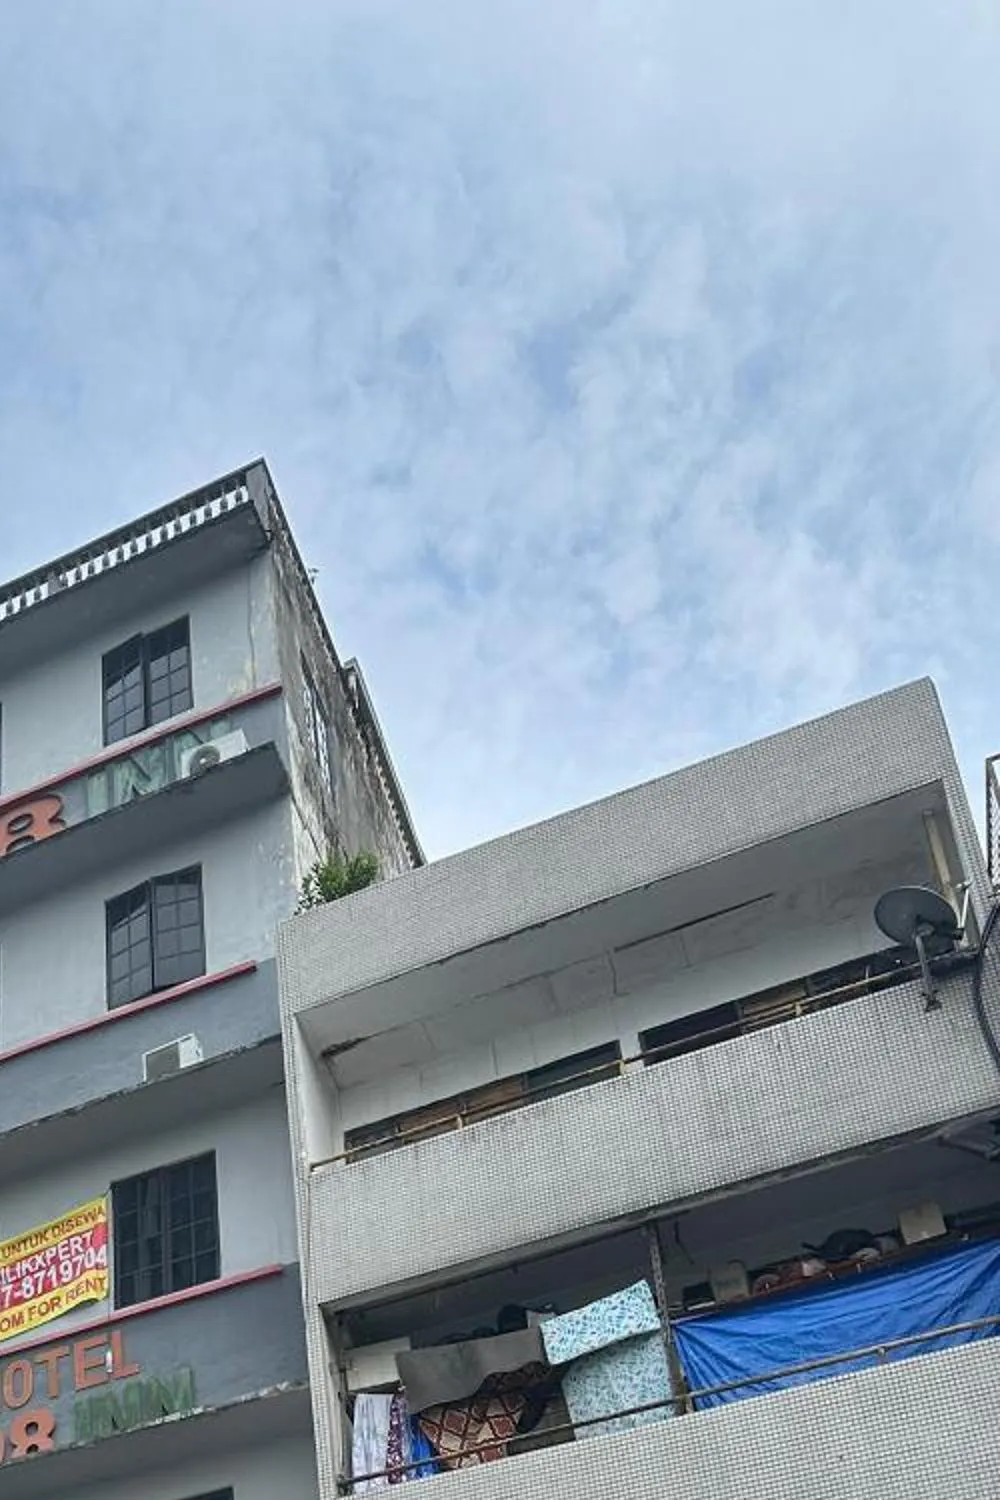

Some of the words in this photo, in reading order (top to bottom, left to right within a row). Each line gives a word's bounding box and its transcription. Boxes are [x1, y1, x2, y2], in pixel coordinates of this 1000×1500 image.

[2, 1232, 49, 1260] UNTUK
[50, 1205, 105, 1239] DISEWA
[27, 1296, 62, 1321] FOR
[65, 1275, 107, 1304] RENT
